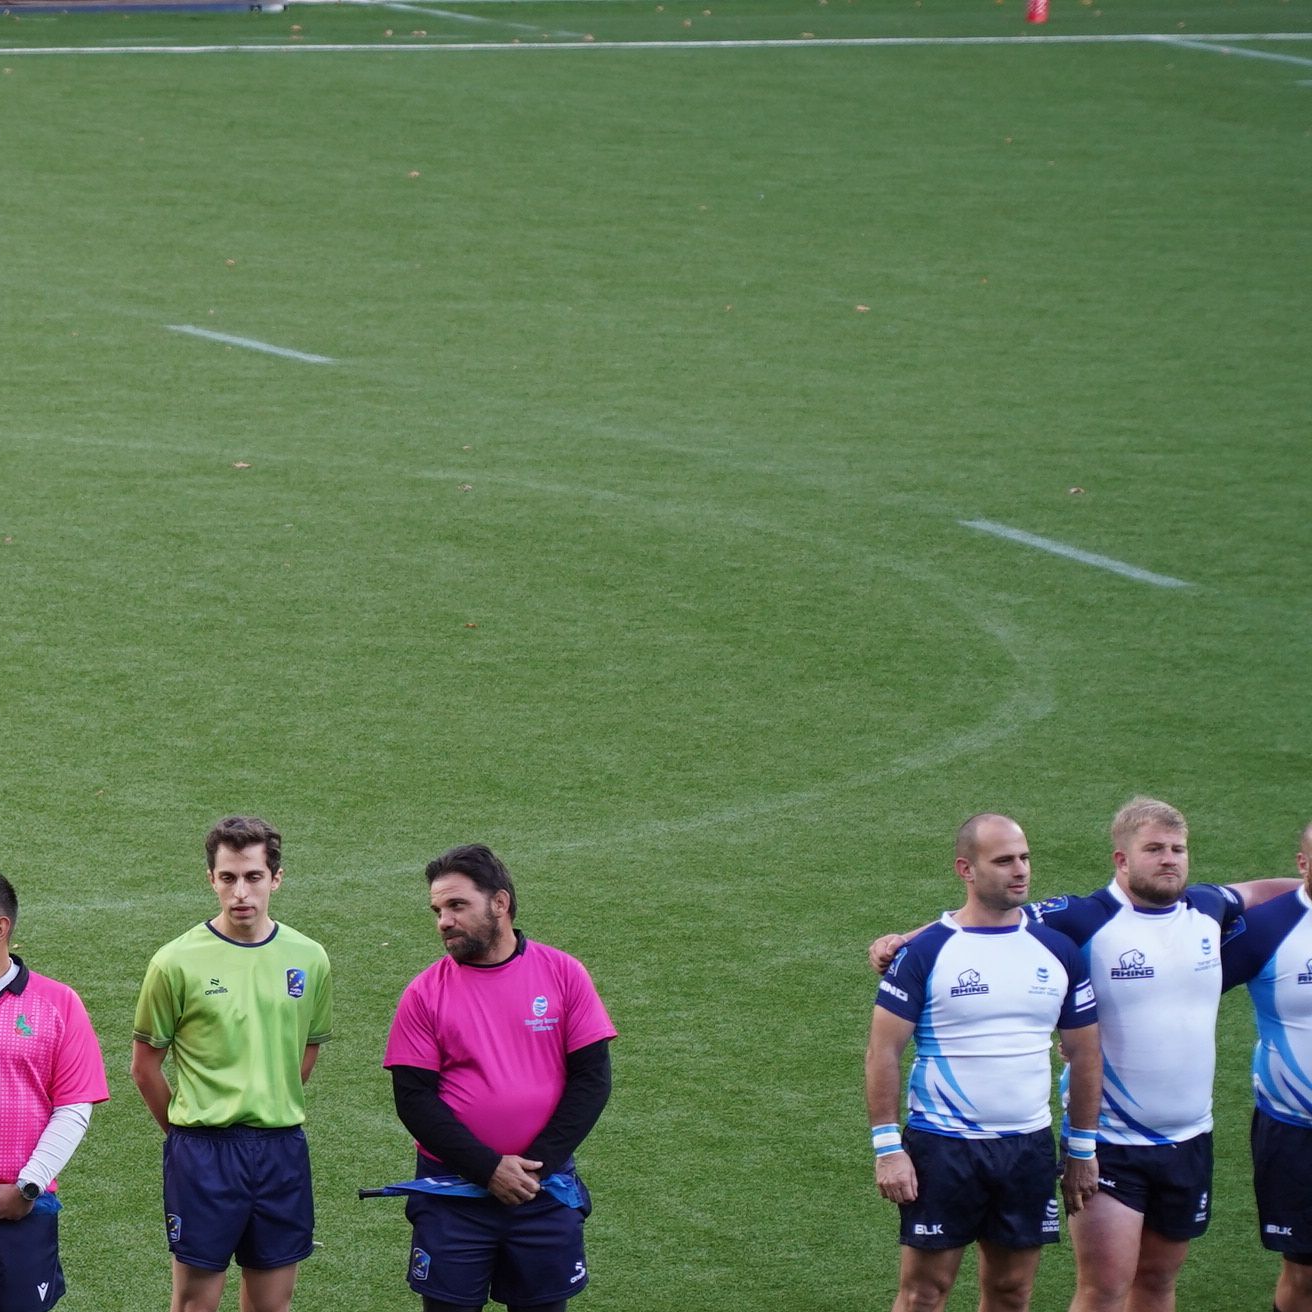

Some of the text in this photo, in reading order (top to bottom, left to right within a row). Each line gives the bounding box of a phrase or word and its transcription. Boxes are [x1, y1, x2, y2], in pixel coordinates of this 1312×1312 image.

[951, 986, 989, 995] RHINO
[1098, 1177, 1116, 1188] LK
[914, 1223, 944, 1235] BLK
[1266, 1224, 1293, 1236] BLK
